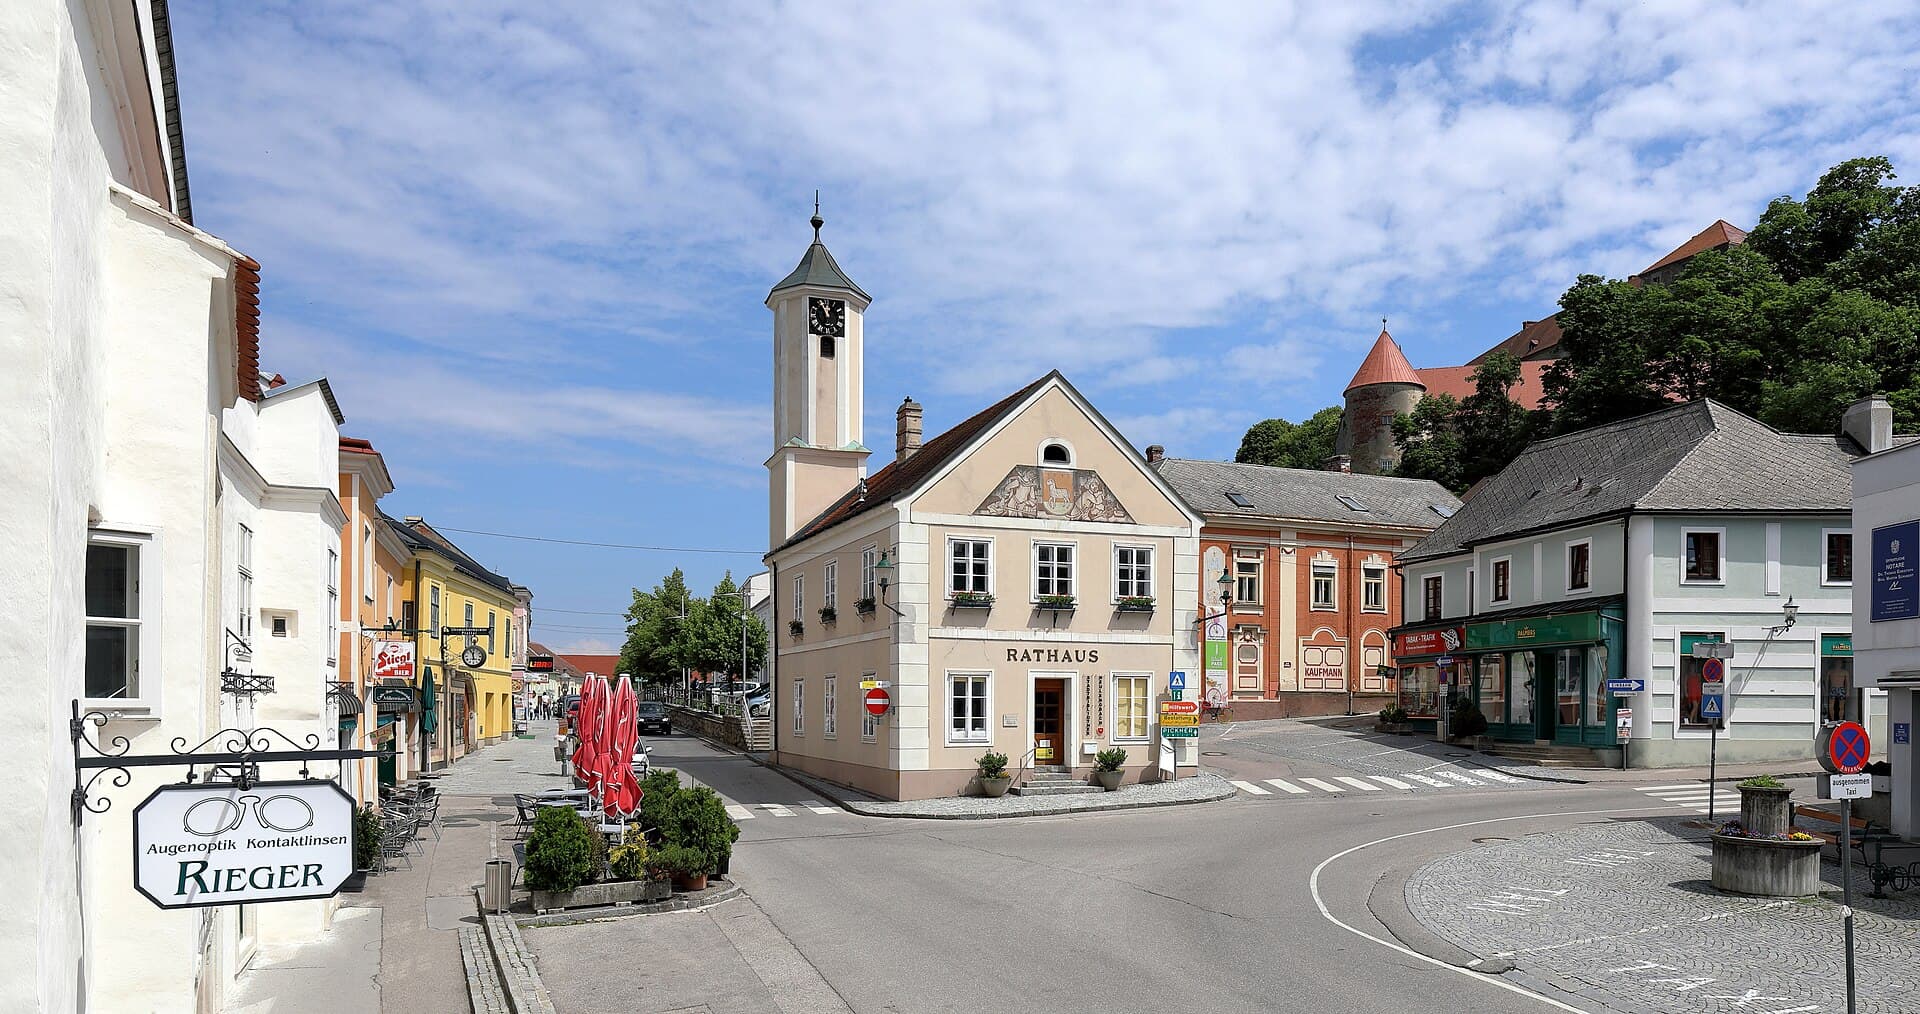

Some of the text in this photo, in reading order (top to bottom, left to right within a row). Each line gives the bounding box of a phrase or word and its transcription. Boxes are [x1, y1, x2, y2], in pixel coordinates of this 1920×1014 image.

[1885, 562, 1905, 570] NOTARE
[1405, 635, 1418, 644] TABAK
[1421, 633, 1436, 642] TRAFIK
[377, 650, 411, 669] Stiegl
[1006, 648, 1099, 663] RATHAUS
[1304, 667, 1343, 677] KAUFMANN
[1840, 765, 1861, 773] ANFANG
[1832, 778, 1870, 787] ausgenommen
[1846, 787, 1857, 795] Taxi
[146, 835, 347, 856] Augenoptik Kontaktlinsen
[173, 860, 324, 896] RIEGER
